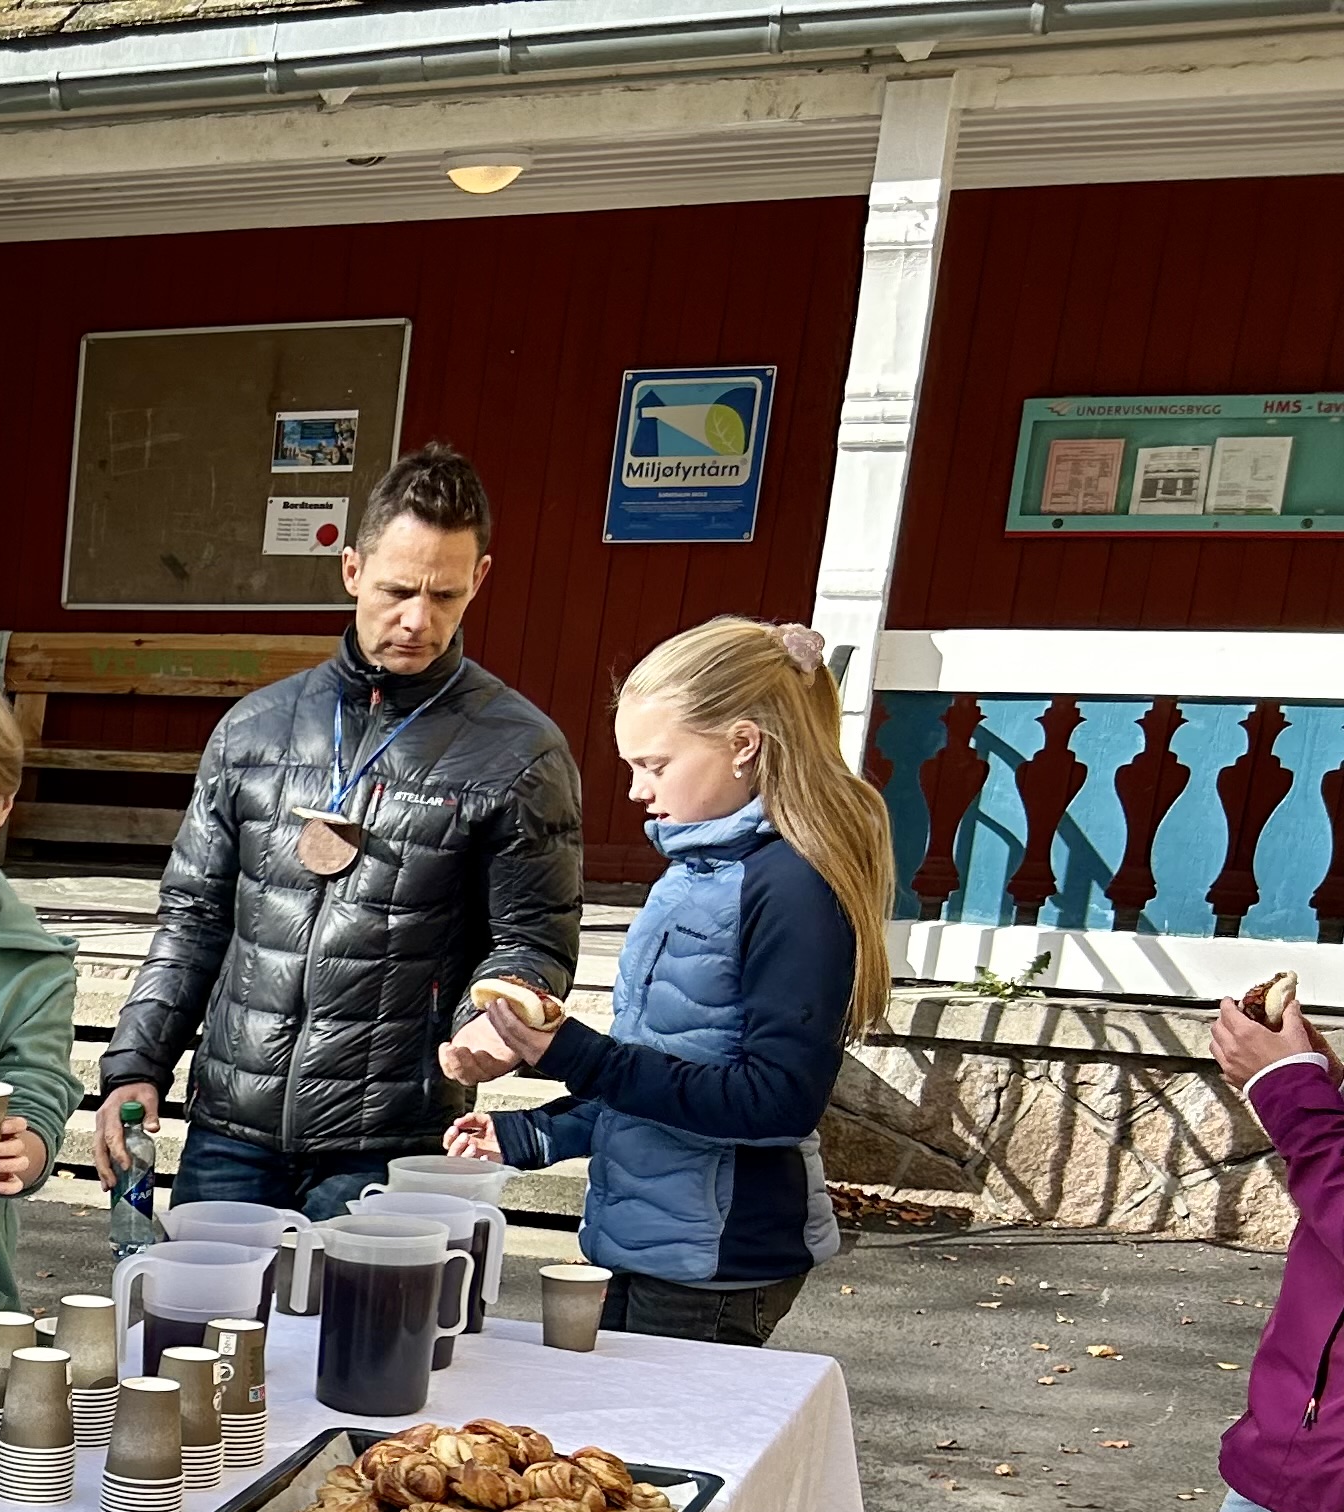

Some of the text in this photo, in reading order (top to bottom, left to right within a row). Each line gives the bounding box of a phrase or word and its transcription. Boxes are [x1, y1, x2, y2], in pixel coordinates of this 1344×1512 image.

[1076, 404, 1223, 417] UNDERVISNINGSBYGG
[1263, 400, 1302, 413] HMS
[625, 460, 741, 483] Miljøfyrtårn
[282, 501, 334, 510] Bordtennis
[393, 791, 444, 806] STELLAR
